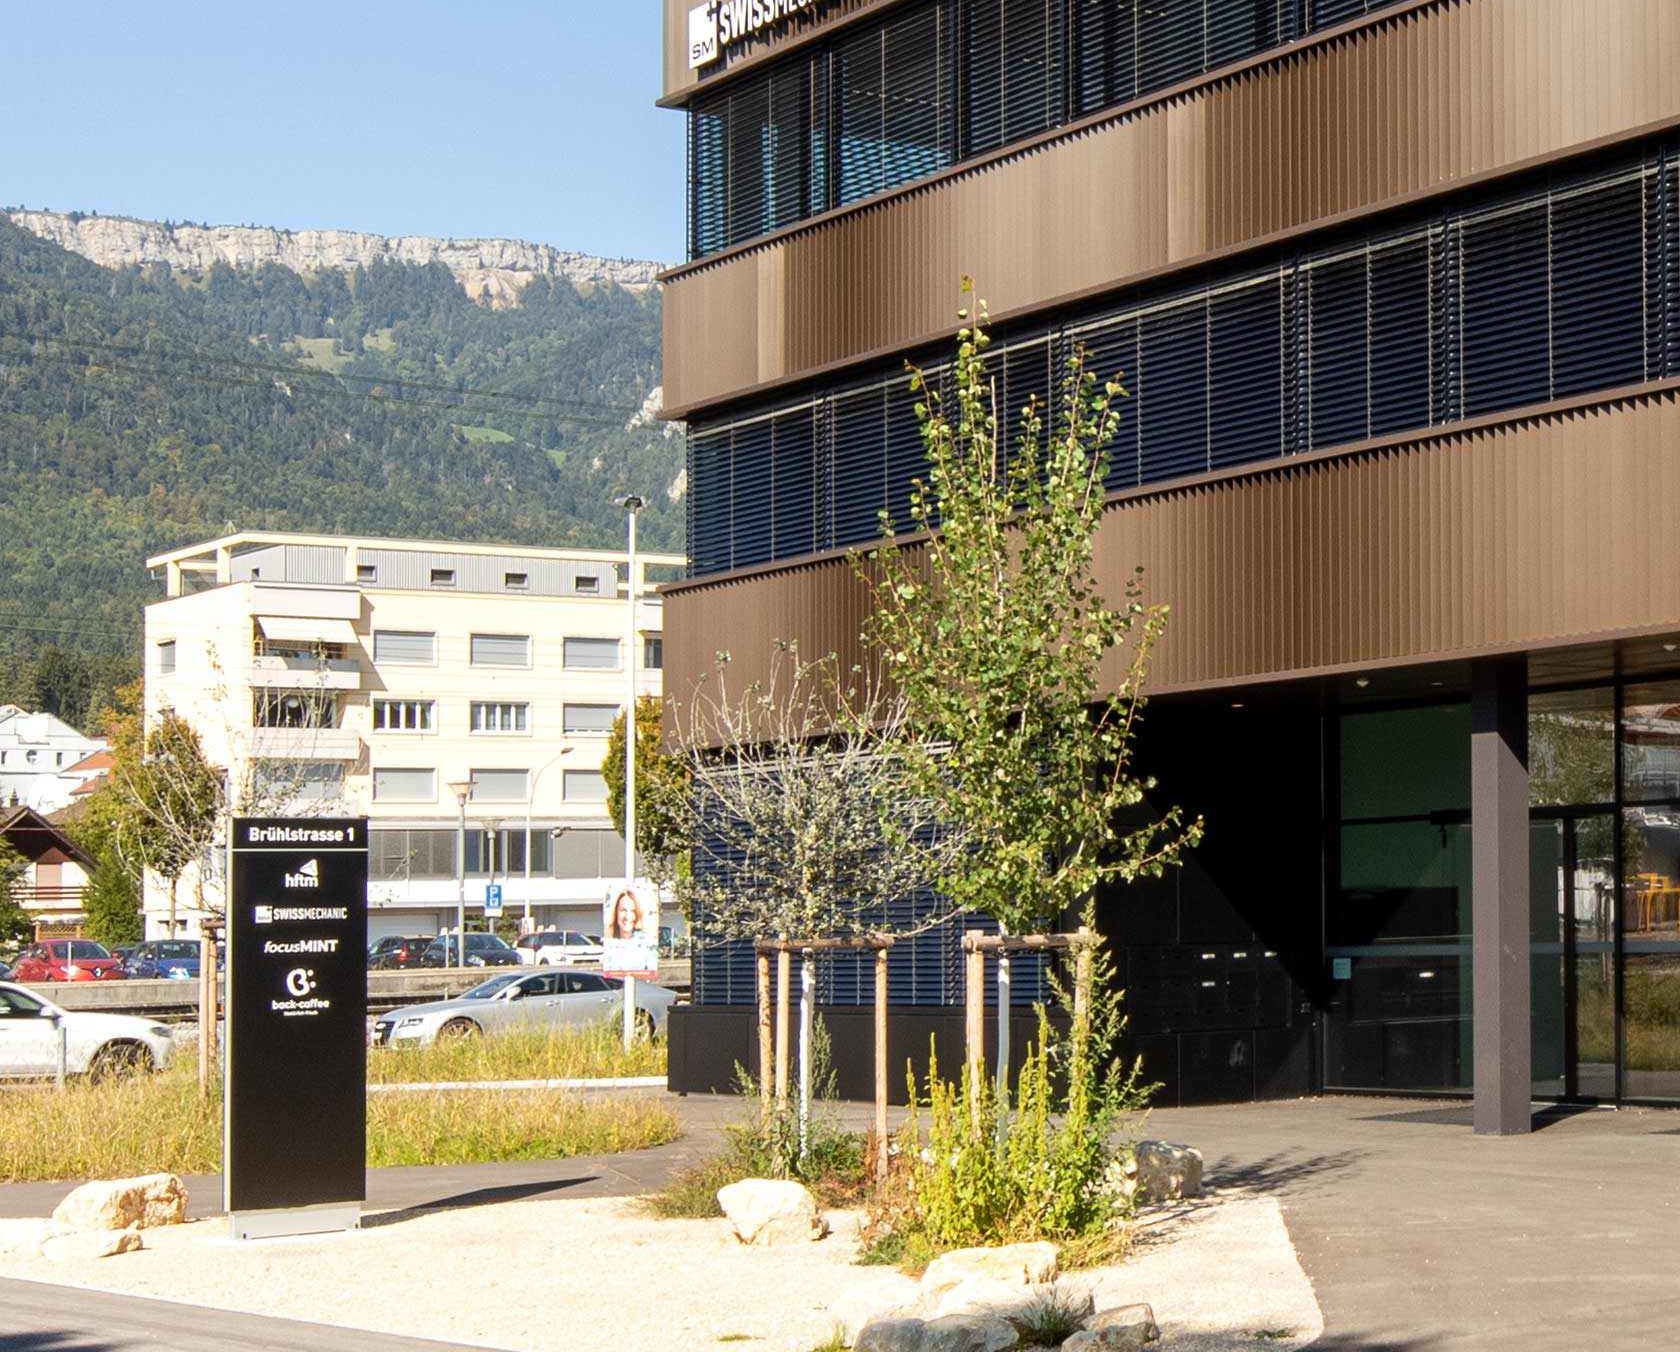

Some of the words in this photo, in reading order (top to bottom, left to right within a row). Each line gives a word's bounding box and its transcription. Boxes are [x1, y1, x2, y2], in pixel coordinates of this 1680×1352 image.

[692, 37, 714, 60] SM
[249, 827, 344, 841] Brühlstrasse
[346, 827, 355, 841] 1
[285, 873, 318, 888] hftm
[273, 907, 348, 920] SWISSMECHANIC
[264, 939, 339, 953] focusMINT
